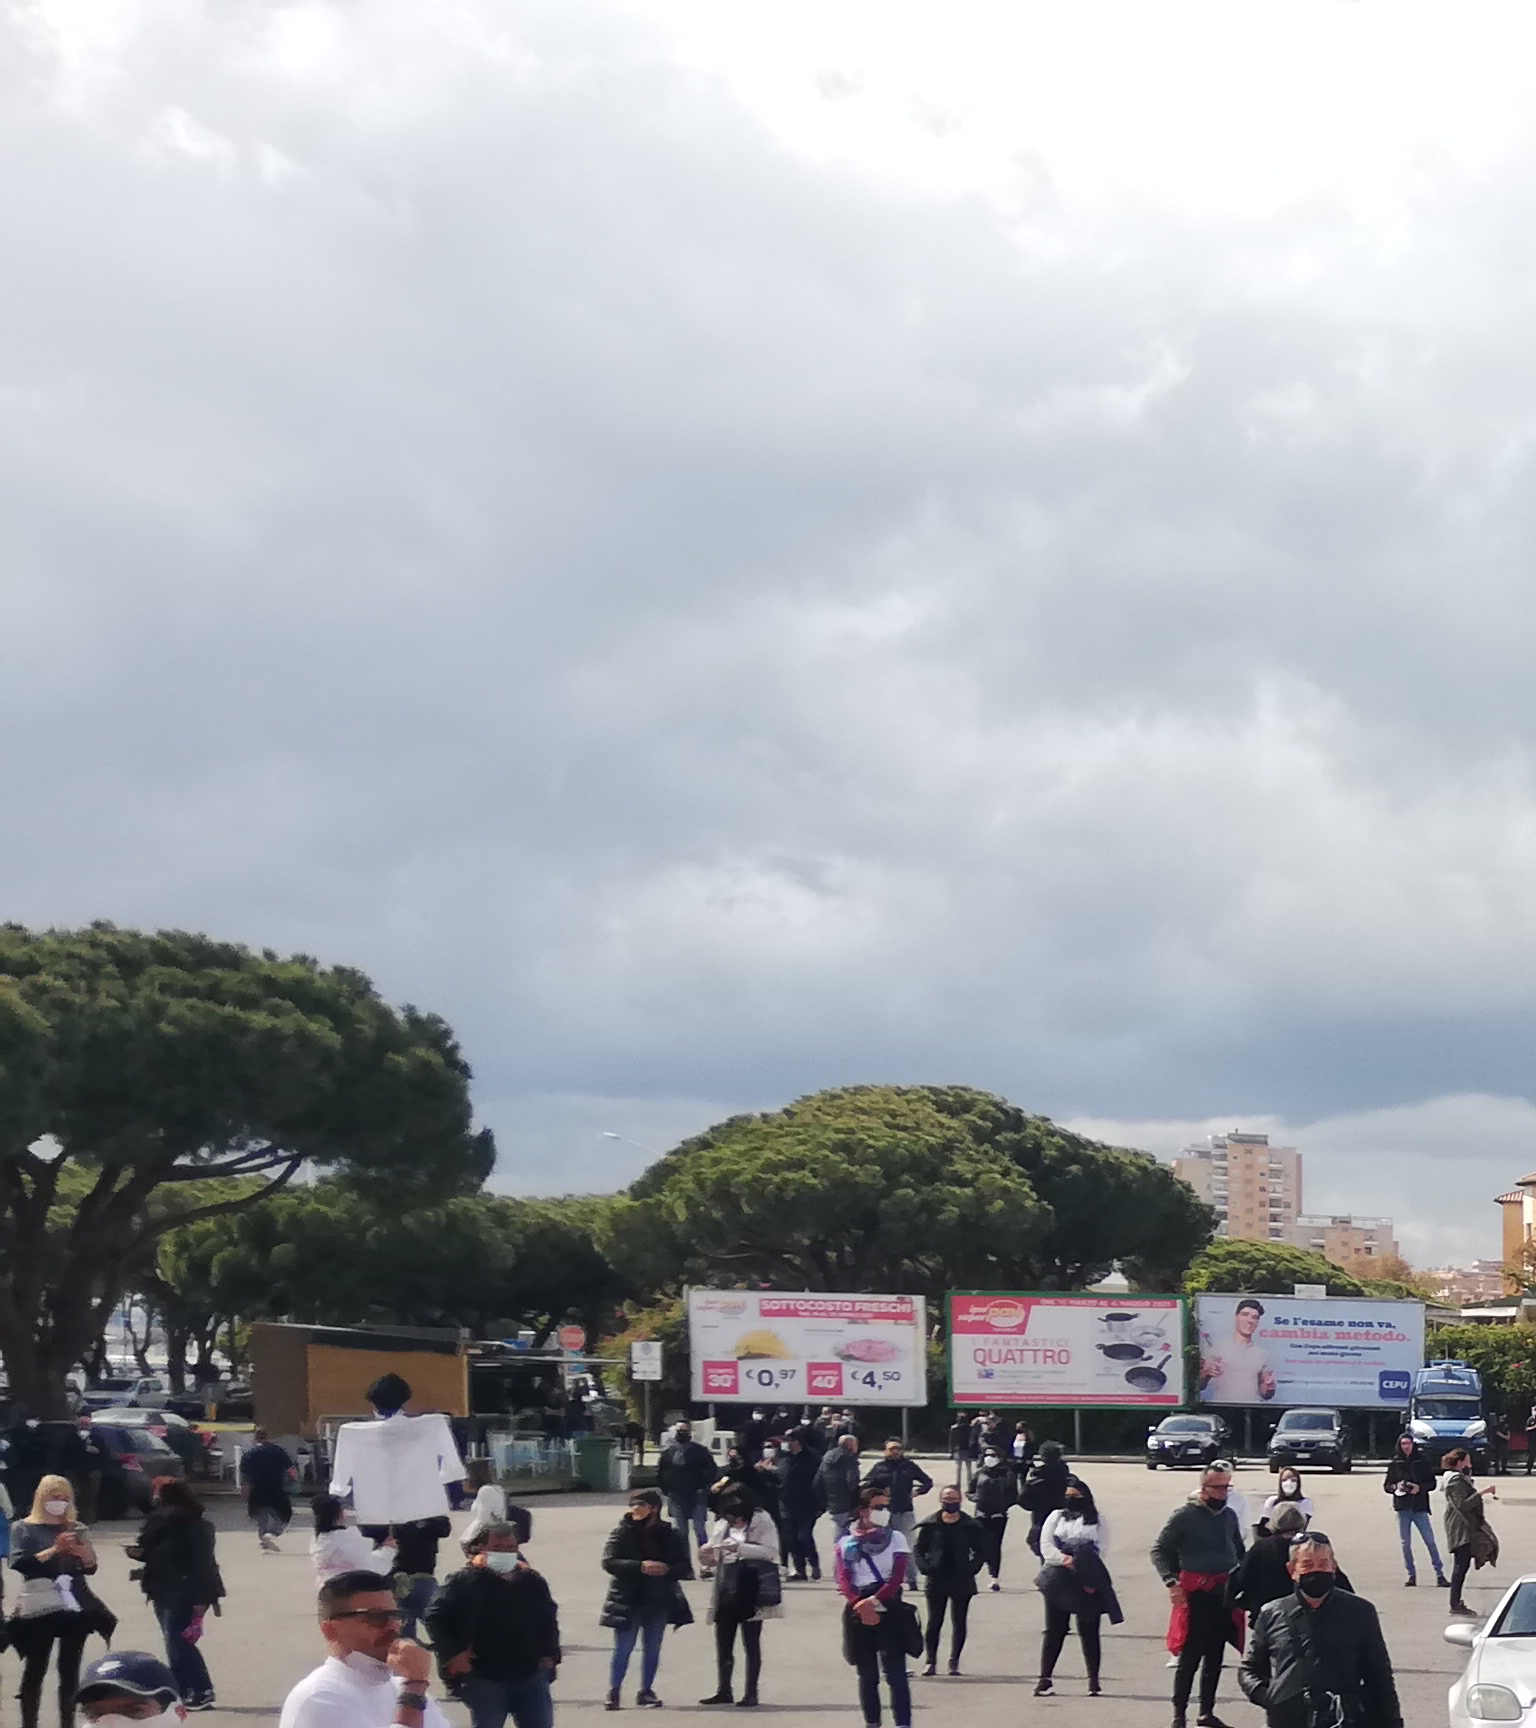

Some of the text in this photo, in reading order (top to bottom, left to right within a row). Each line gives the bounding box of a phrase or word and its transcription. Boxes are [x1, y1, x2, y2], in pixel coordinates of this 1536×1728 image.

[761, 1300, 853, 1311] SOTTOCOSTO
[855, 1302, 911, 1313] FRESCHI
[1274, 1316, 1290, 1325] Se
[1292, 1317, 1345, 1328] l'esame
[1347, 1320, 1375, 1328] non
[1259, 1328, 1411, 1342] cambia metodo.
[983, 1337, 1070, 1347] FANTASTICI
[973, 1348, 1071, 1366] QUATTRO
[1382, 1380, 1409, 1389] CEPU
